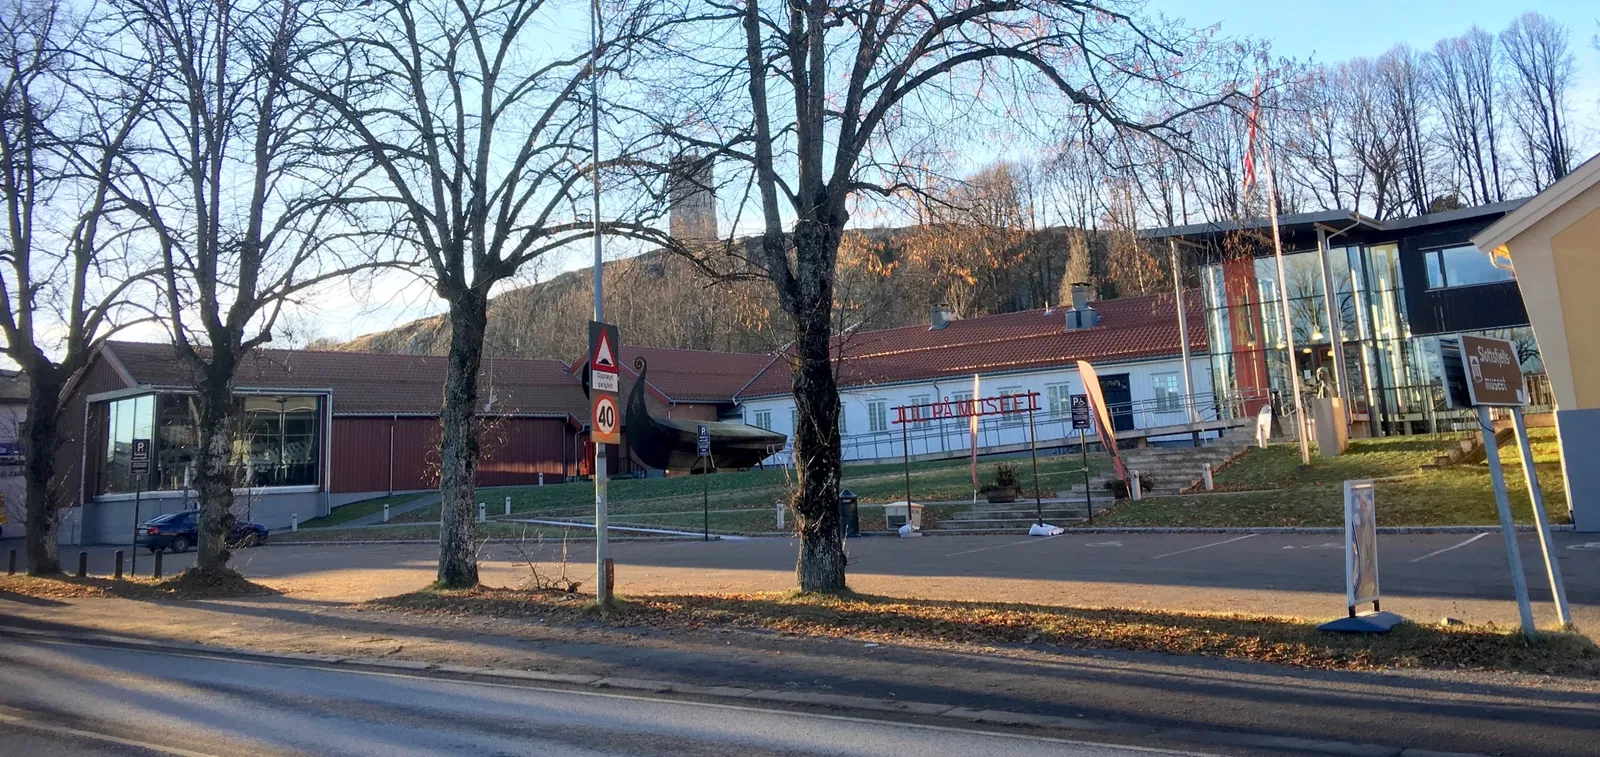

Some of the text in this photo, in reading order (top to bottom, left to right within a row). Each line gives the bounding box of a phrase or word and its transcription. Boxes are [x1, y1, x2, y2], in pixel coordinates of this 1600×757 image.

[1484, 376, 1507, 391] museet
[891, 391, 1041, 424] JUL PÅ MUSEET
[1072, 398, 1078, 406] P
[598, 405, 614, 428] 40
[138, 442, 144, 452] P
